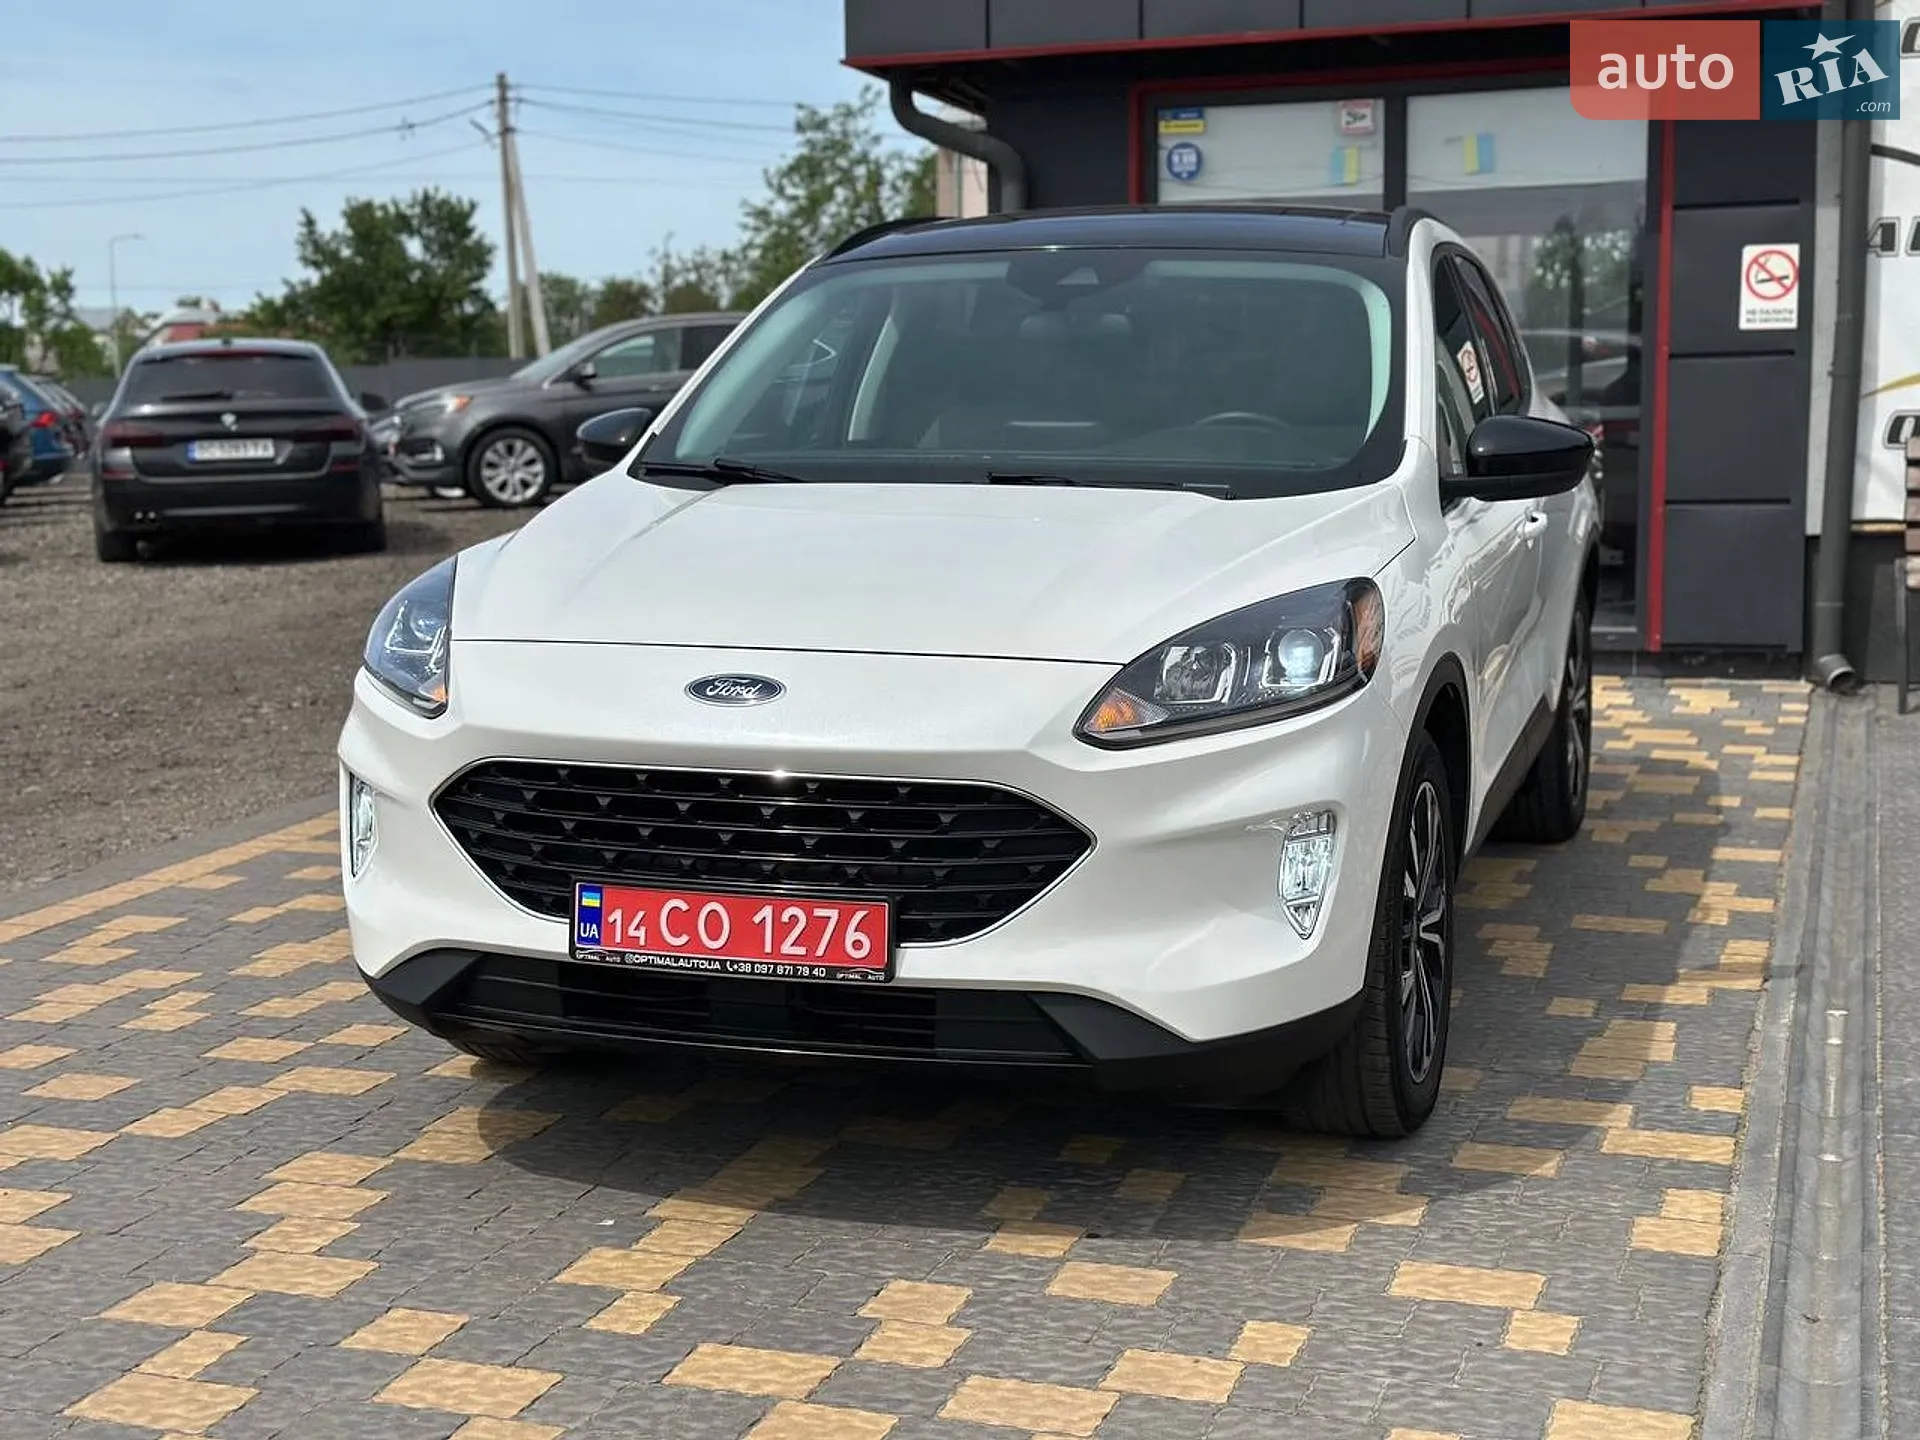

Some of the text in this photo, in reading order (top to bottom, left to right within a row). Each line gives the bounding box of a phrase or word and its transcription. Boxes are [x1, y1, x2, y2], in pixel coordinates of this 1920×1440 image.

[706, 679, 762, 699] Ford
[580, 922, 599, 939] UA
[607, 898, 872, 960] 14 CO 1276
[812, 967, 827, 978] 40
